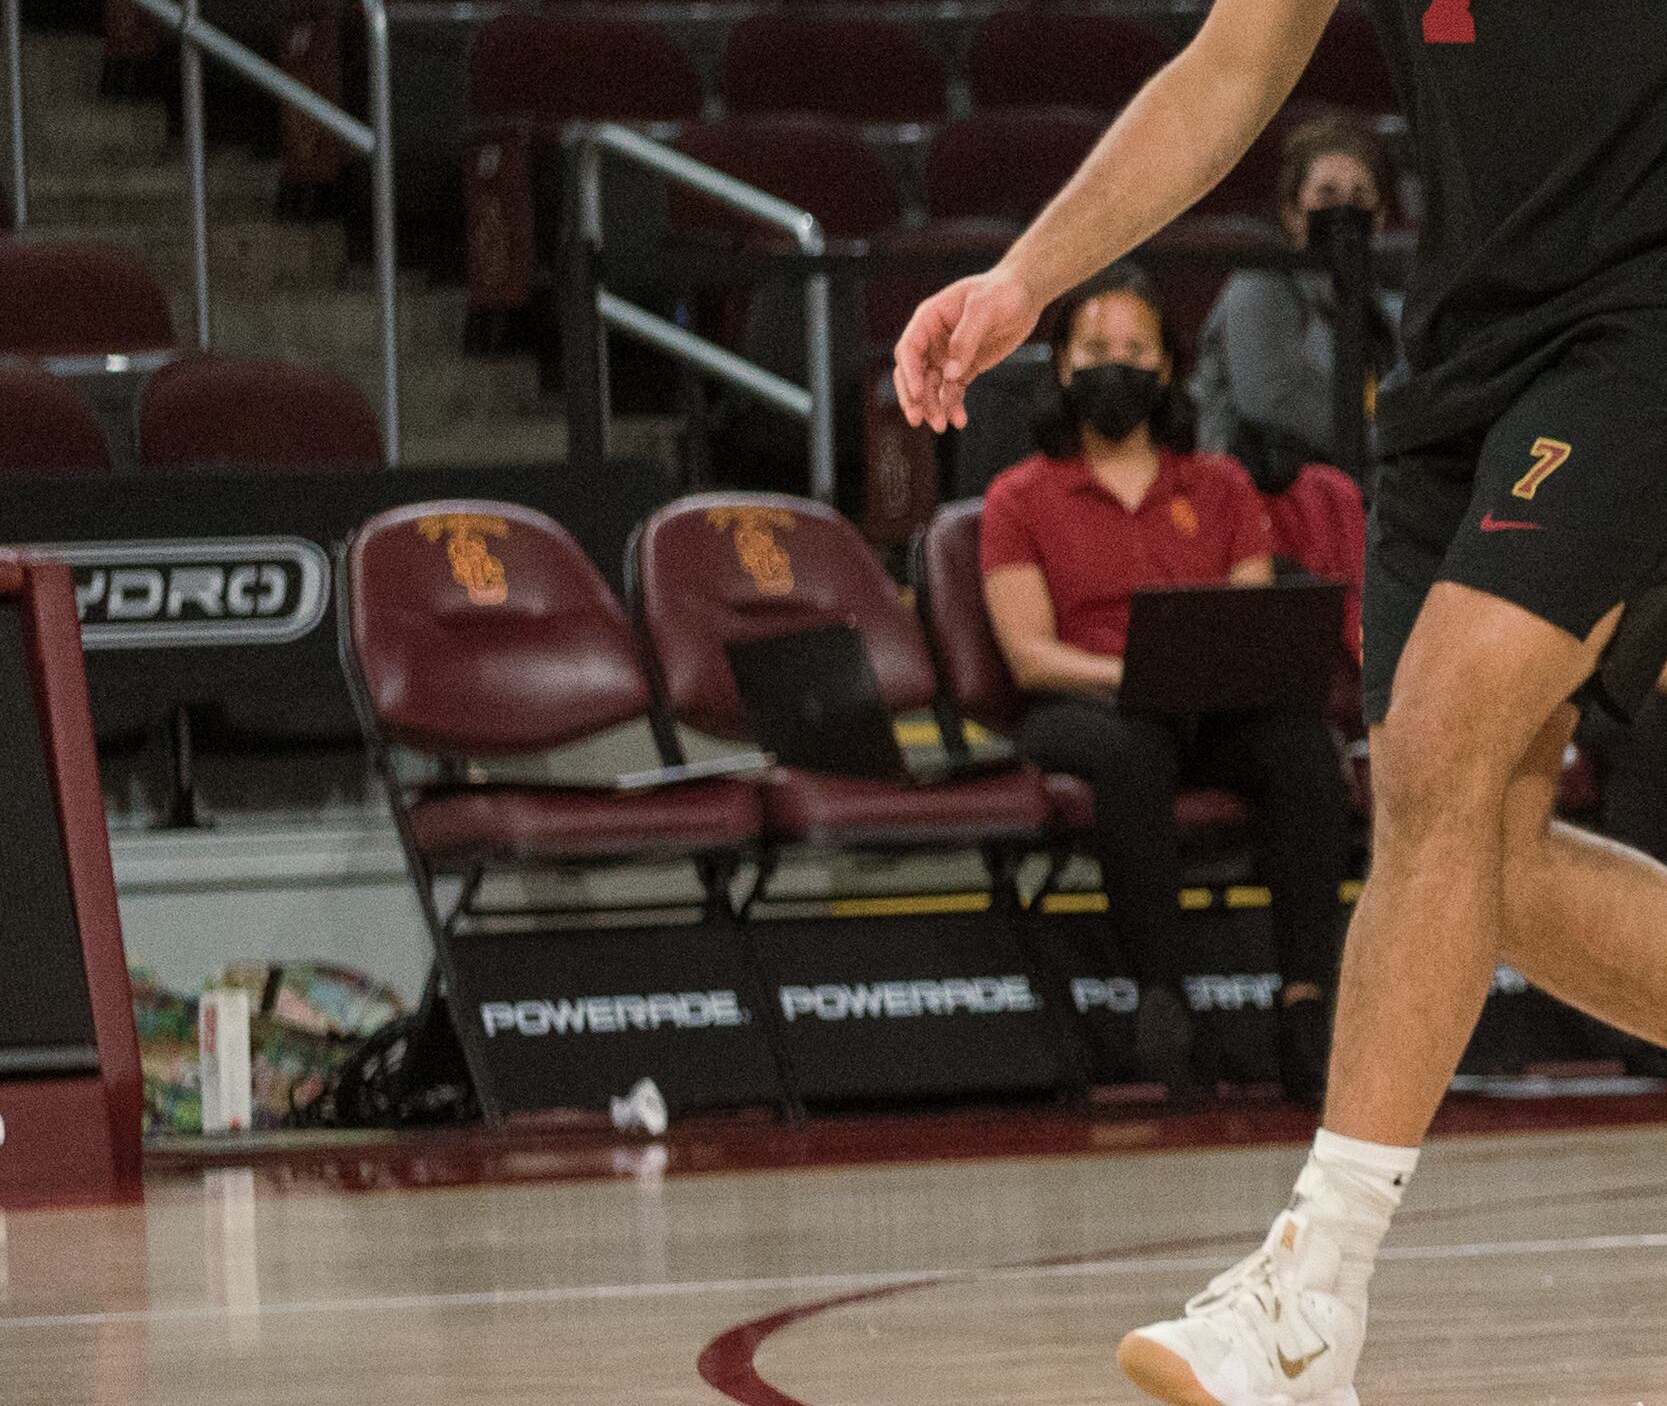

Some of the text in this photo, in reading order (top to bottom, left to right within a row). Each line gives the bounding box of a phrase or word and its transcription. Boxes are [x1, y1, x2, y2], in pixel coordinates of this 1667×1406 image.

[1512, 438, 1571, 500] 7
[76, 560, 289, 620] YDRO
[480, 989, 741, 1038] POWERADE
[779, 974, 1034, 1022] POWERADE
